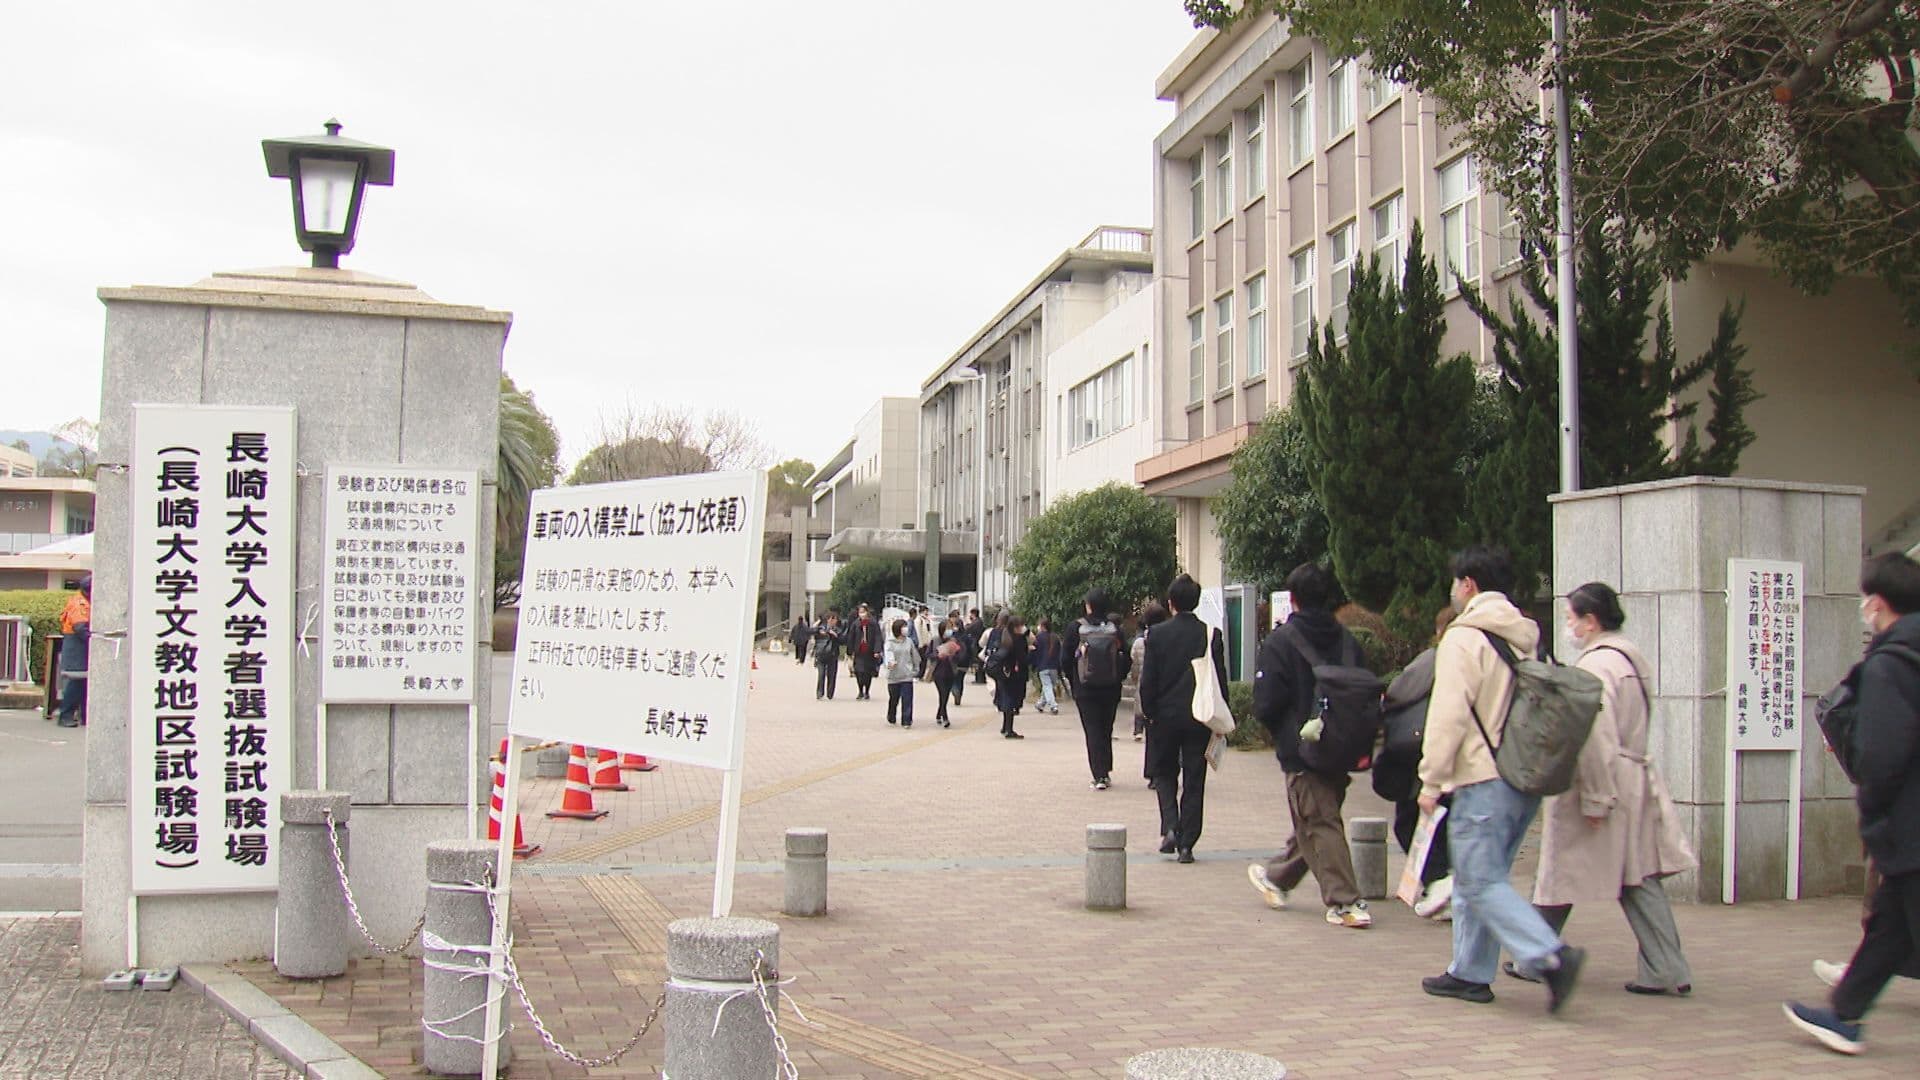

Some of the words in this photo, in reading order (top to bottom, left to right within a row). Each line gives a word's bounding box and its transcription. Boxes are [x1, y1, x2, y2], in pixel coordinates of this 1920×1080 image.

[337, 475, 467, 496] 受験者及び関係者各位
[347, 500, 456, 516] 試験場構内における
[533, 496, 748, 540] 車両の入構禁止（協力依頼）
[347, 517, 444, 532] 交通規制について
[336, 539, 465, 554] 現在文教地区構内は交通
[335, 556, 459, 571] 規制を実施しています。
[334, 572, 465, 588] 試験場の下見及び試験当
[334, 589, 464, 604] 日においても受験者及び
[333, 622, 464, 636] 等による構内乗り入れに
[527, 605, 671, 632] の入構を禁止いたします。
[1748, 571, 1759, 676] ご協力願います。
[224, 432, 268, 866] 長崎大学入学者選抜試験場
[1760, 571, 1772, 721] 立ち入りを禁止します。
[154, 446, 200, 869] （長崎大学文教地区試験場）
[332, 655, 410, 669] 留意願います。
[528, 640, 729, 680] 正門付近での駐停車もご遠慮くだ
[402, 675, 464, 690] 長崎大学
[519, 676, 545, 699] さい。
[1738, 683, 1748, 738] 長崎大学
[645, 708, 709, 742] 長崎大学
